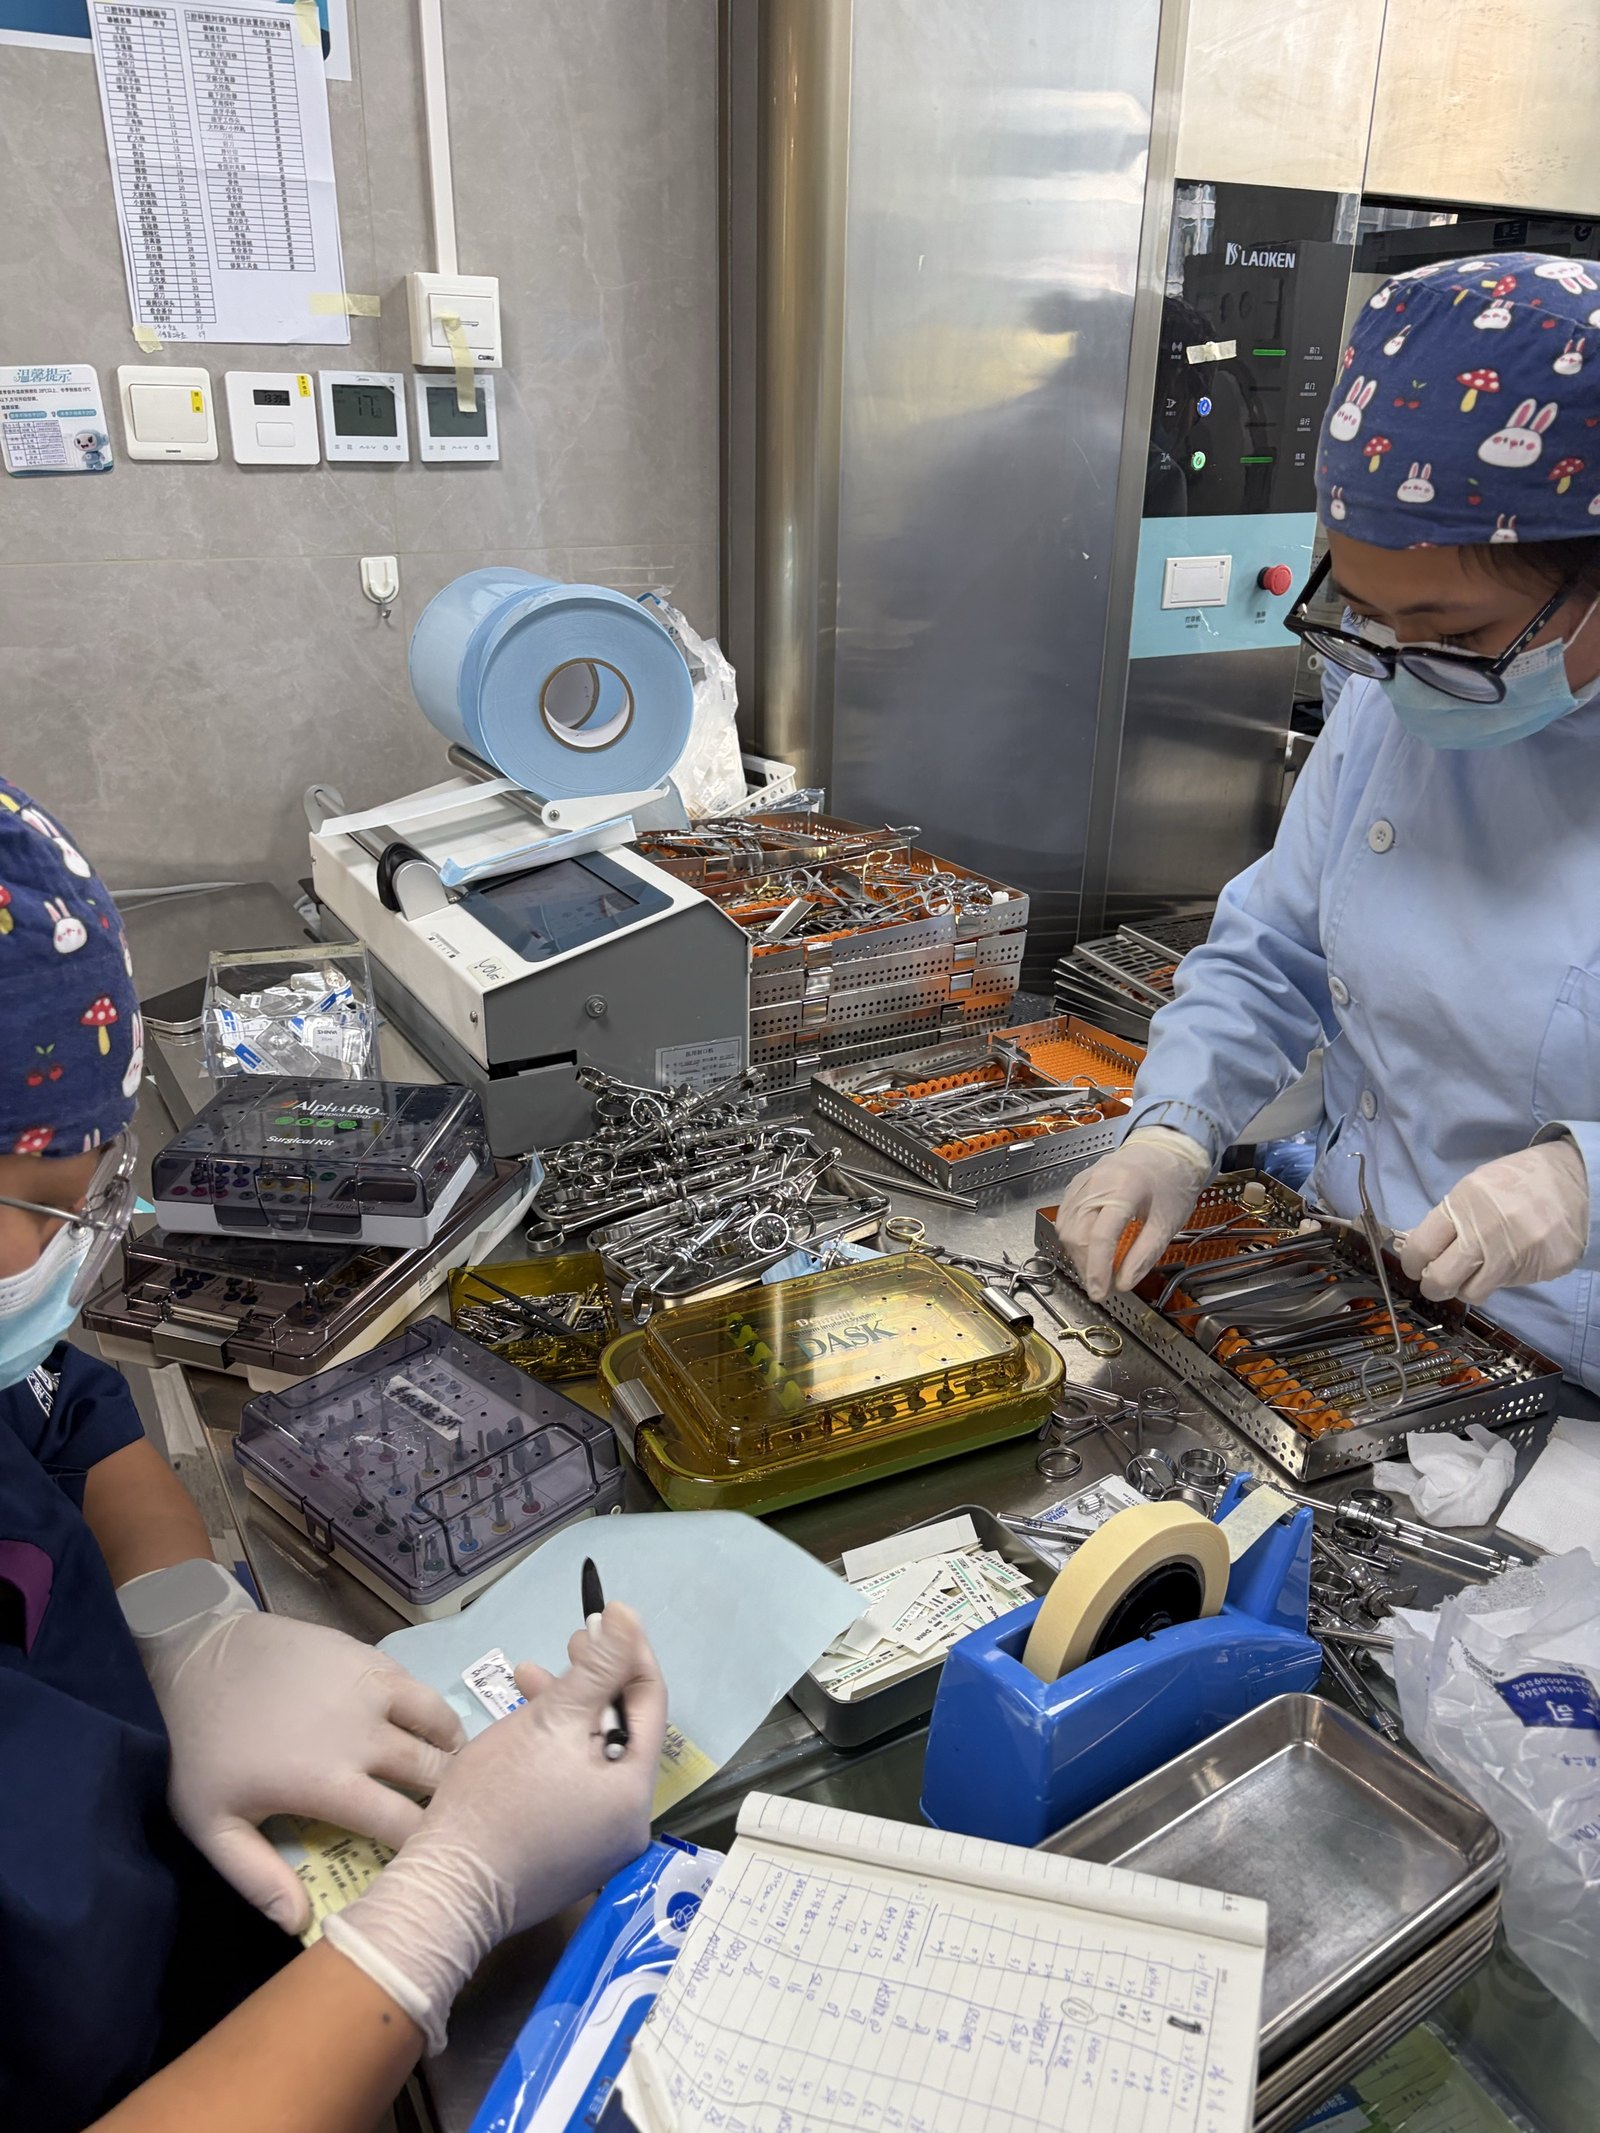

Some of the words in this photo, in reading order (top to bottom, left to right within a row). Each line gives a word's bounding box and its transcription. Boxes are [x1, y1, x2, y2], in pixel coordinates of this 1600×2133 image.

[1240, 249, 1296, 269] LAOKEN
[17, 368, 72, 383] 温馨提示
[266, 1135, 314, 1148] Surgical
[314, 1136, 335, 1147] Kit
[797, 1318, 897, 1363] DASK
